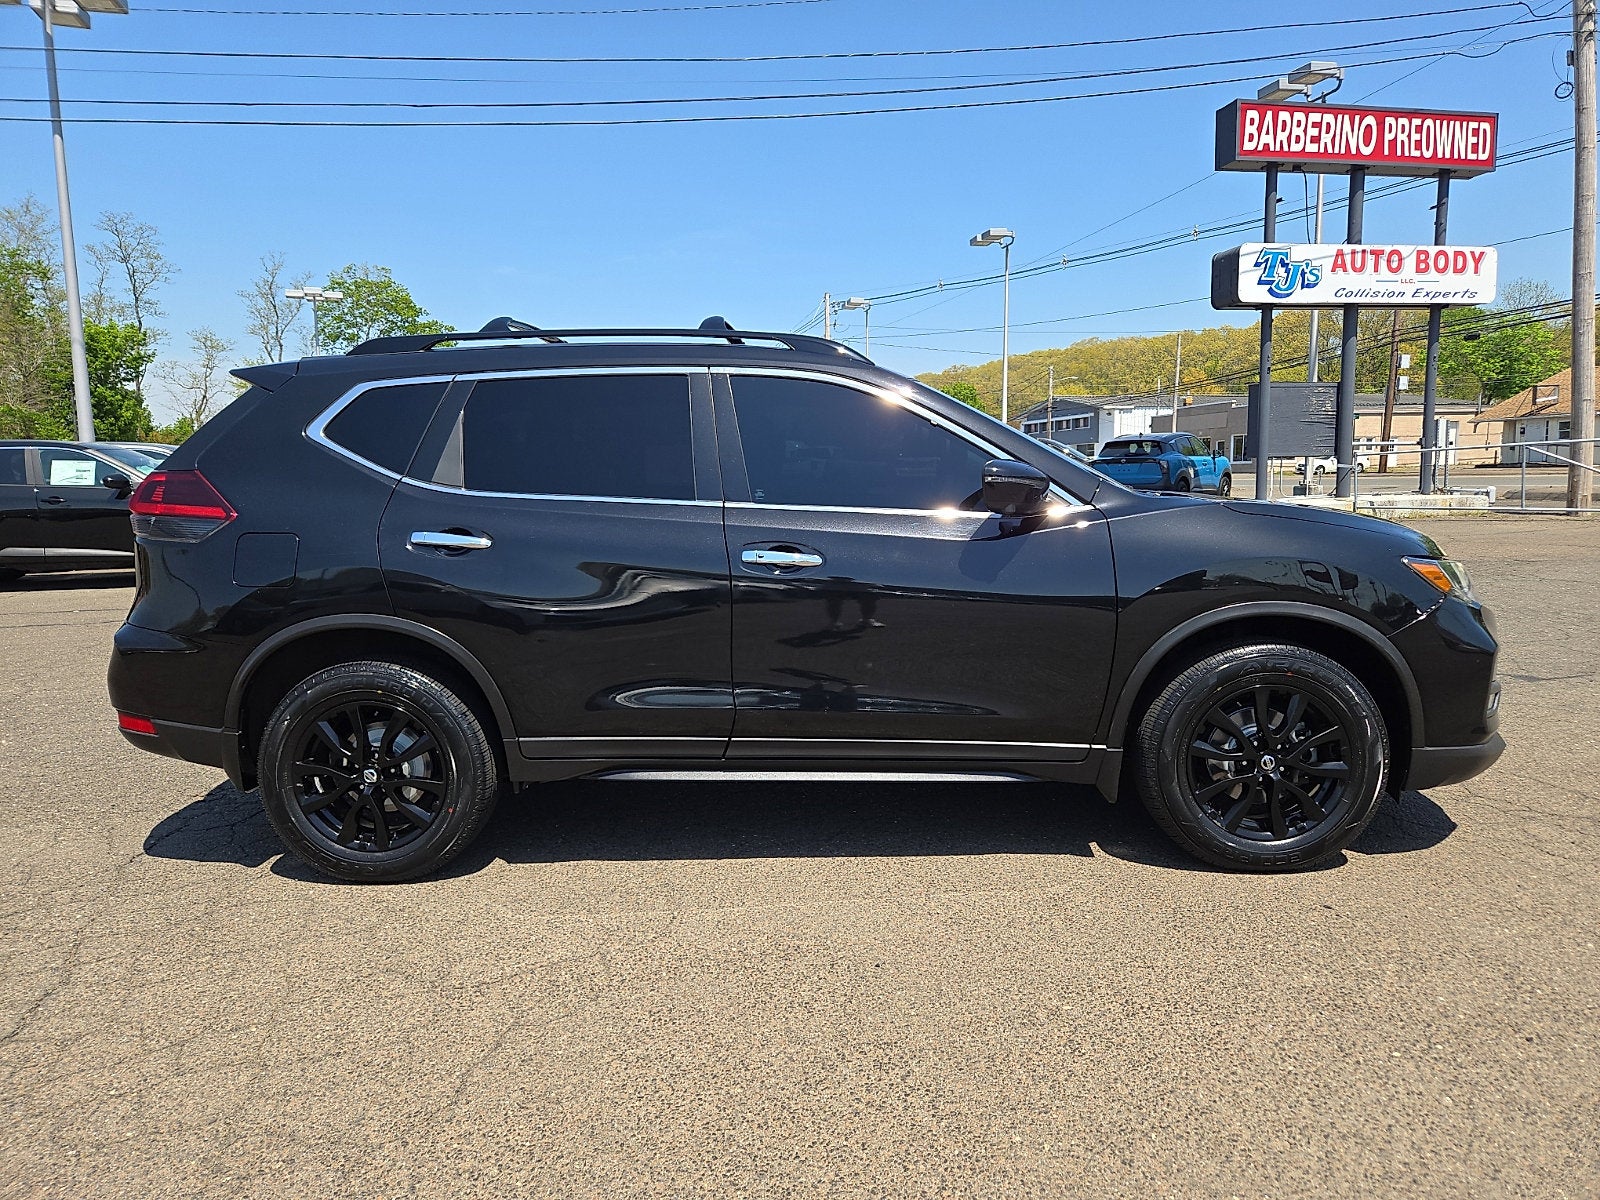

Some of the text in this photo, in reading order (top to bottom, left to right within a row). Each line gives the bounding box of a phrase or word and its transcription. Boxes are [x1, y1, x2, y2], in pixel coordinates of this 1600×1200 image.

[1242, 109, 1491, 161] BARBERINO PREOWNED
[1331, 249, 1486, 275] AUTO BODY
[1334, 287, 1478, 300] Collision Experts
